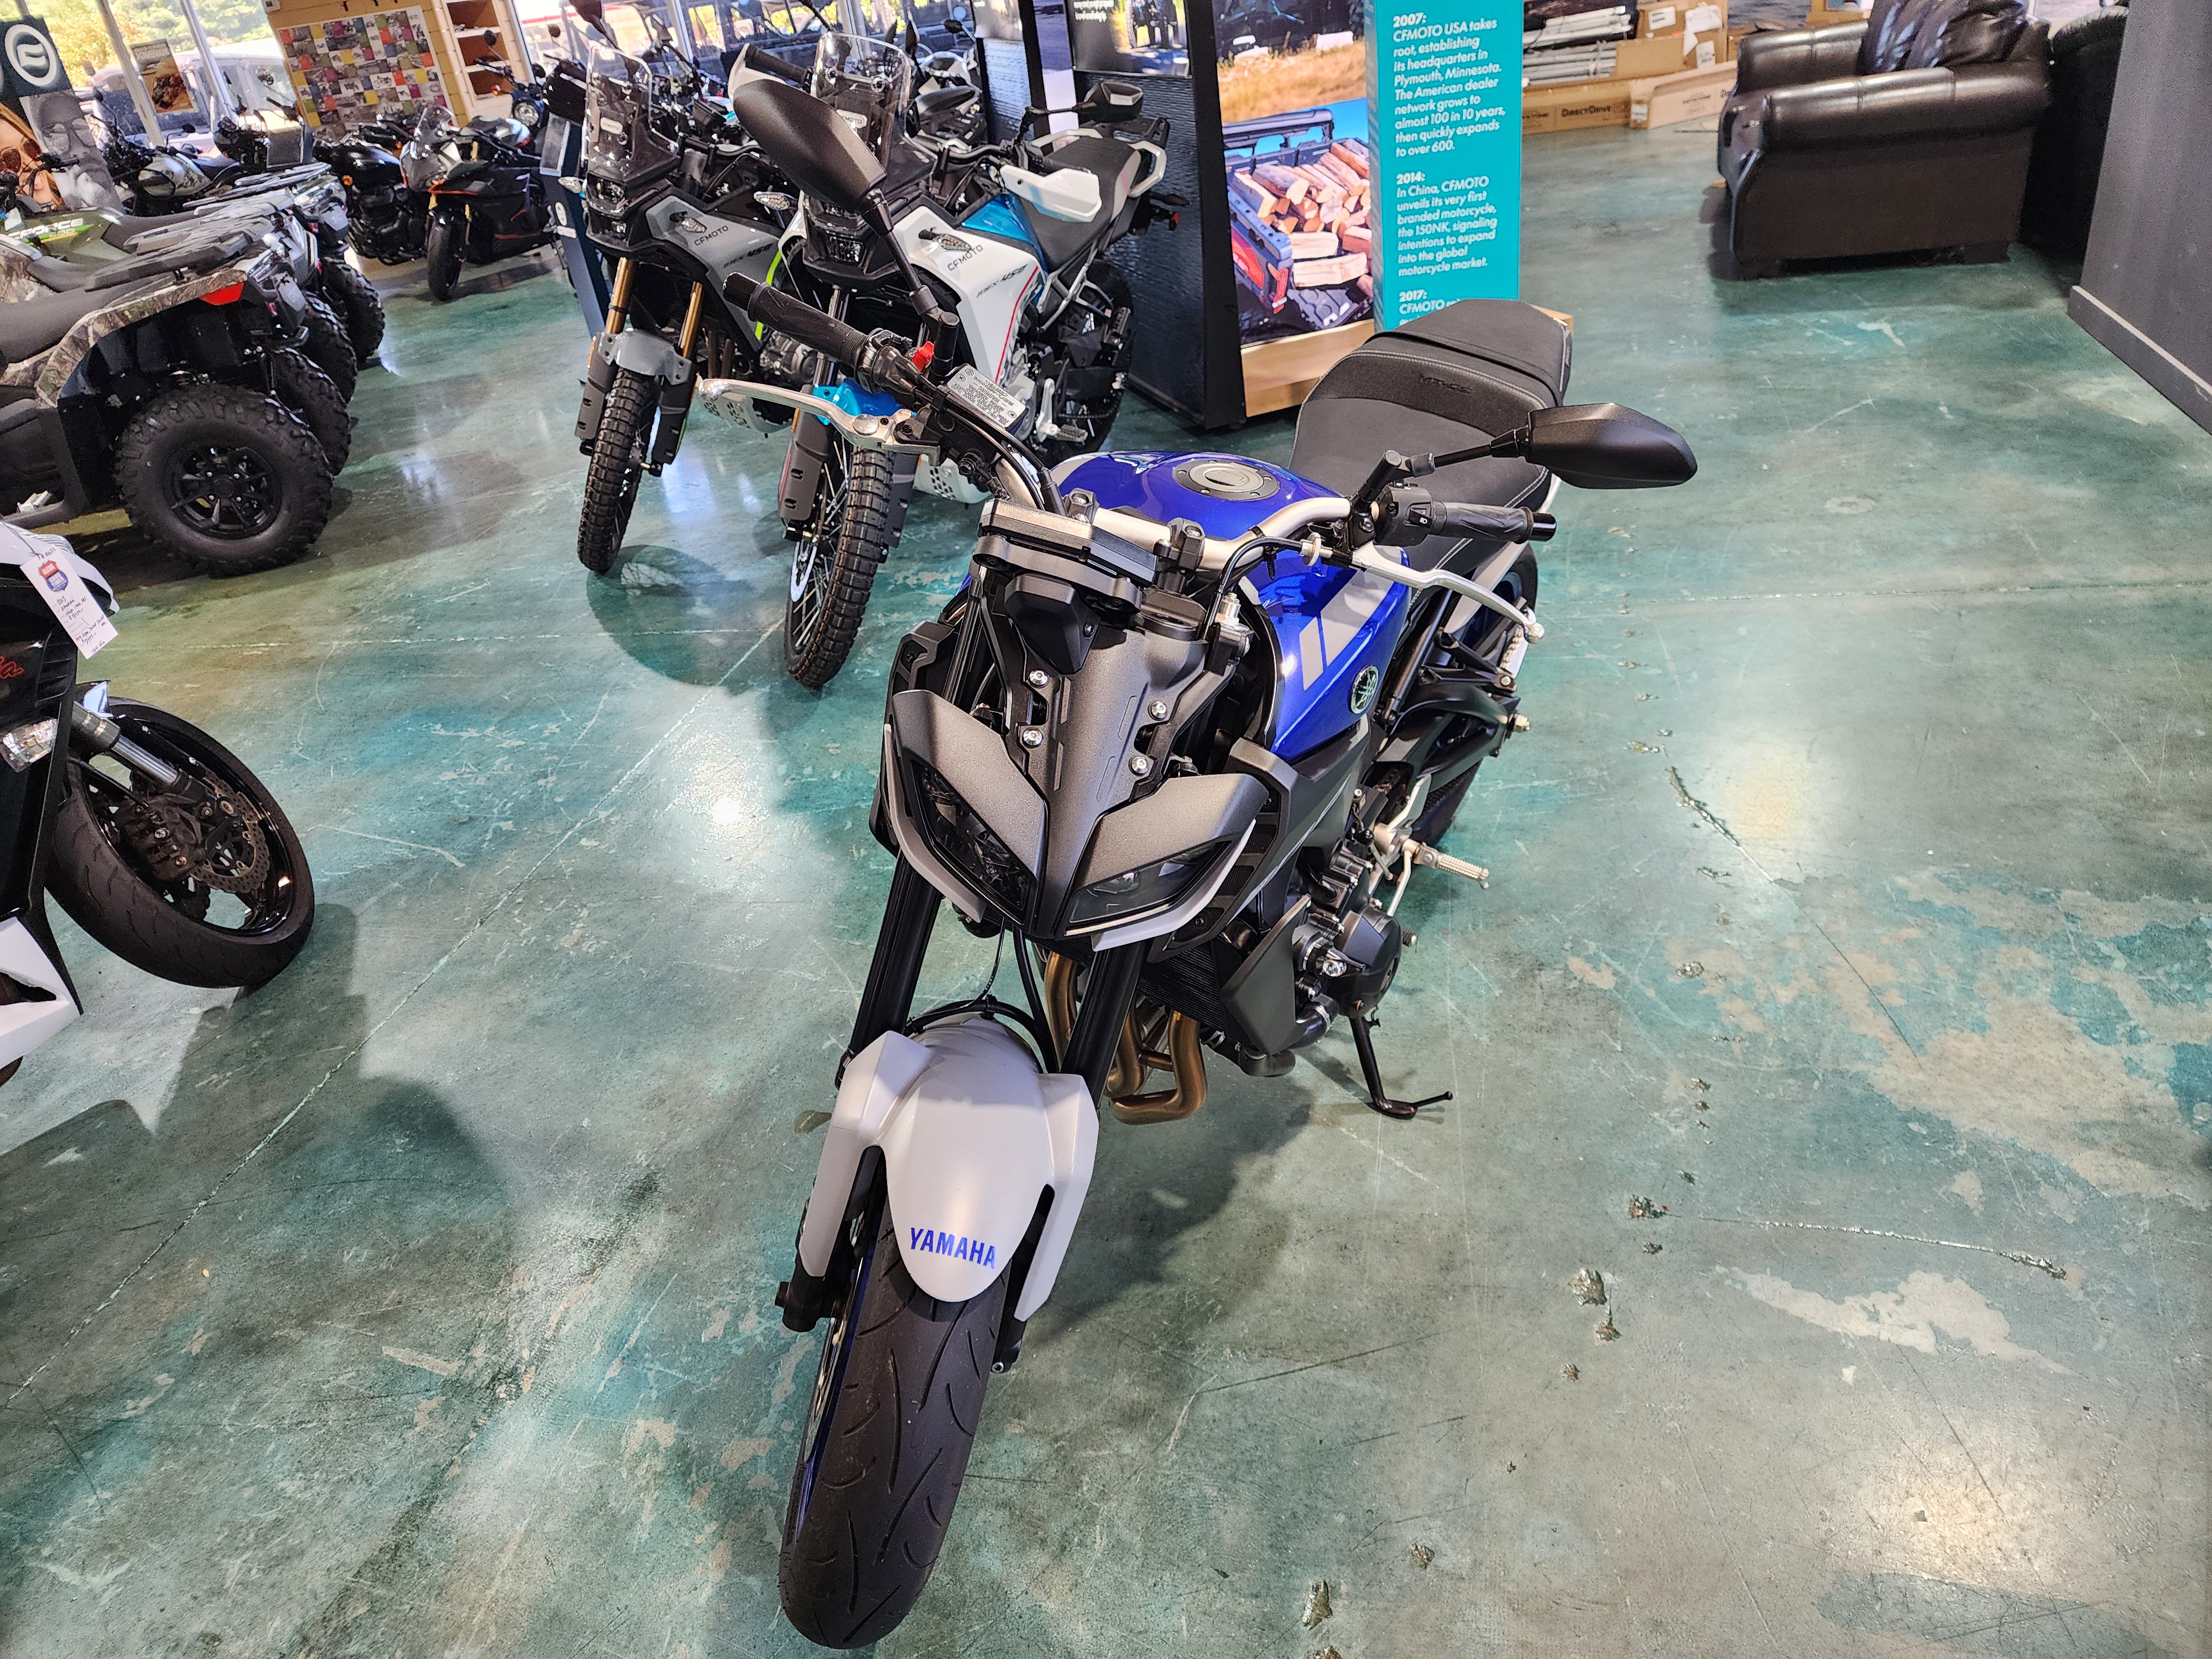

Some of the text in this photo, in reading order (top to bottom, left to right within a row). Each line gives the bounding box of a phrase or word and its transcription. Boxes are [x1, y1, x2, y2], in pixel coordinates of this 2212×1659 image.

[1393, 12, 1427, 28] 2007:
[1393, 18, 1498, 43] CFMOTO USA takes
[1394, 36, 1480, 58] root, establishing
[1394, 49, 1488, 72] its headquarters in
[1394, 62, 1502, 88] Plymouth, Minnesota.
[1395, 76, 1499, 101] The American dealer
[1395, 95, 1481, 115] network grows to
[1395, 107, 1506, 129] almost 100 in 10 years,
[1395, 118, 1500, 143] then quickly expands
[1396, 139, 1455, 157] to over 600.
[1396, 170, 1426, 185] 2014:
[1396, 175, 1489, 198] In China, CFMOTO
[1396, 190, 1487, 211] unveils its very first
[1397, 202, 1497, 225] branded motorcycle,
[694, 225, 729, 246] CFMOTO
[1397, 216, 1498, 238] the 150NK, signaling
[1397, 228, 1496, 251] intentions to expand
[947, 244, 983, 271] CFMOTO
[1398, 246, 1468, 264] into the global
[1399, 256, 1488, 276] motorcycle market.
[1399, 289, 1427, 302] 2017:
[1399, 299, 1446, 315] CFMOTO
[977, 385, 1000, 403] WARNING
[910, 1227, 995, 1270] YAMAHA
